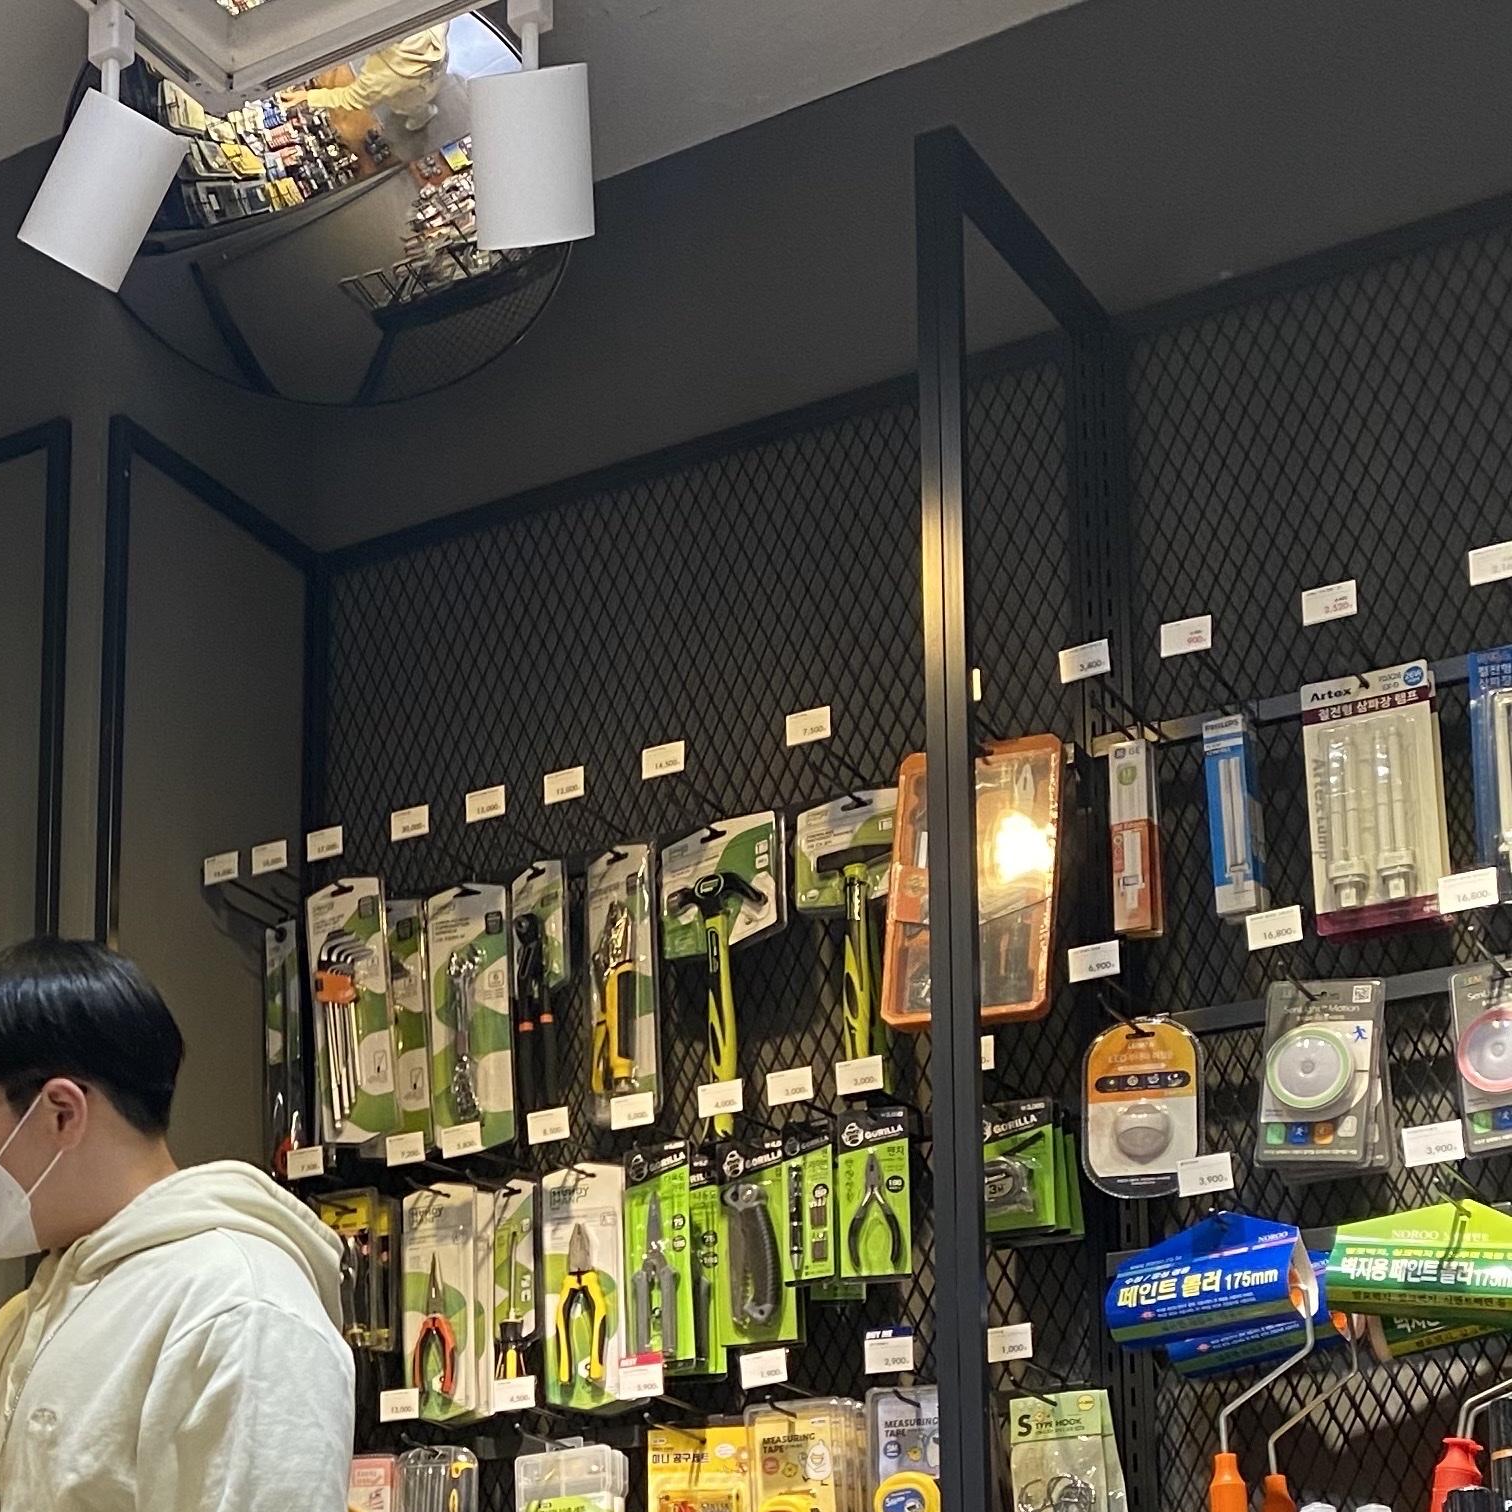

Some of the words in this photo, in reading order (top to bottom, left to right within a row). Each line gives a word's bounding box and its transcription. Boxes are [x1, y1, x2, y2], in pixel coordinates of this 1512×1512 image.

[1310, 685, 1352, 702] Artex
[1318, 705, 1353, 722] 절전형
[1356, 697, 1392, 716] 삼파장
[1394, 689, 1418, 709] 램프
[1204, 718, 1240, 732] PHILIPS
[1262, 926, 1292, 941] 16,800
[992, 1114, 1037, 1133] GORILLA
[864, 1123, 904, 1141] GORILLA
[1199, 1173, 1224, 1186] 3,900
[1258, 1231, 1289, 1244] NOROO
[1391, 1228, 1439, 1240] NOROO
[1342, 1256, 1387, 1280] 벽지용
[1390, 1259, 1439, 1284] 페인트
[1119, 1275, 1178, 1309] 페인트
[1181, 1270, 1221, 1295] 롤러
[1225, 1267, 1279, 1289] 175mm
[763, 1432, 815, 1446] MEASURING
[763, 1445, 784, 1455] TAPE
